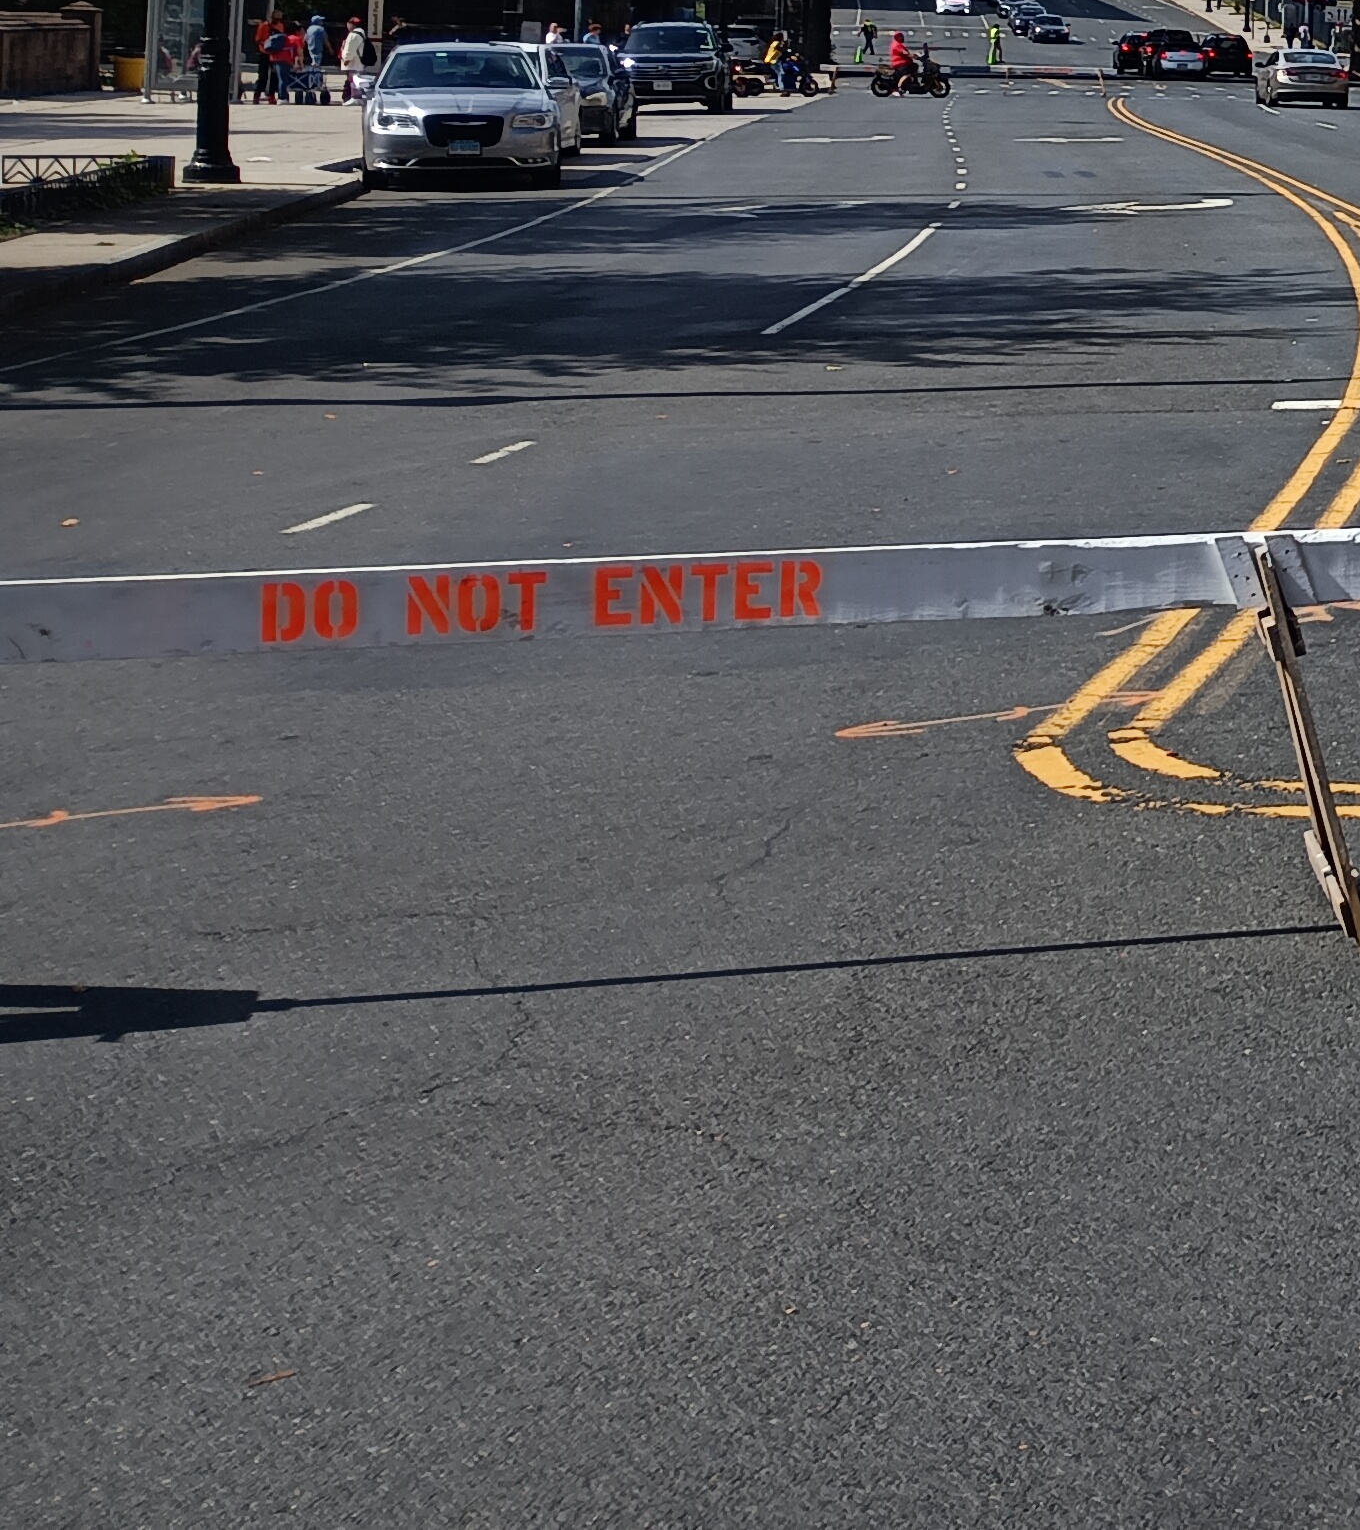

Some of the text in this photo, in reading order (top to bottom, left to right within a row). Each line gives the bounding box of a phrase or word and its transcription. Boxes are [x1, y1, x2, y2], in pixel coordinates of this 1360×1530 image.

[261, 560, 823, 643] DO NOT ENTER
